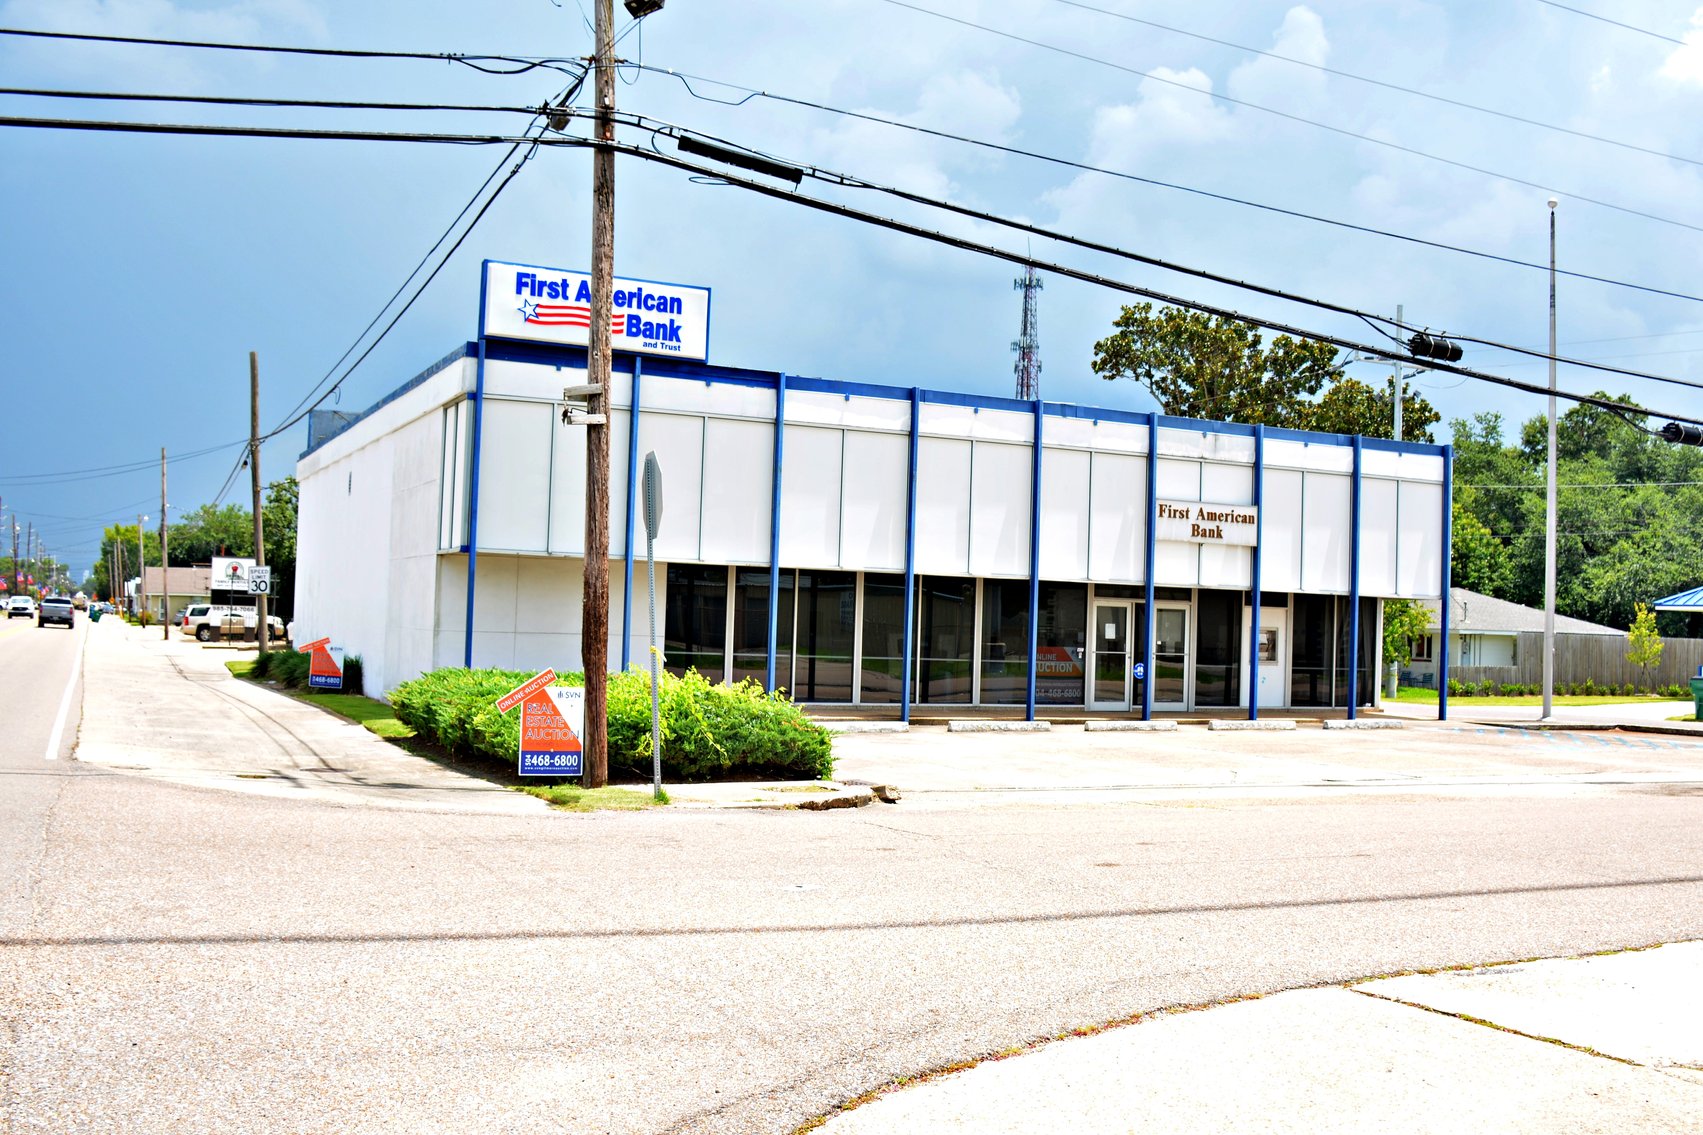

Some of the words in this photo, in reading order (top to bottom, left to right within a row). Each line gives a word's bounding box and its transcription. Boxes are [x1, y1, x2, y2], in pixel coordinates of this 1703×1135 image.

[516, 271, 569, 301] First
[575, 280, 682, 315] Aerican
[626, 313, 683, 343] Bank
[642, 341, 658, 350] and
[660, 342, 681, 352] Trust
[1158, 503, 1190, 520] First
[1196, 506, 1255, 525] American
[1191, 523, 1223, 539] Bank
[251, 579, 268, 592] 30
[1036, 653, 1057, 661] NLINE
[1036, 663, 1073, 673] UCTION
[500, 691, 525, 709] ONLINE
[525, 672, 554, 694] AUCTION
[565, 691, 581, 699] SVN
[527, 703, 554, 715] REAL
[526, 715, 565, 727] ESTATE
[525, 729, 580, 741] AUCTION
[531, 754, 579, 767] 468-6800
